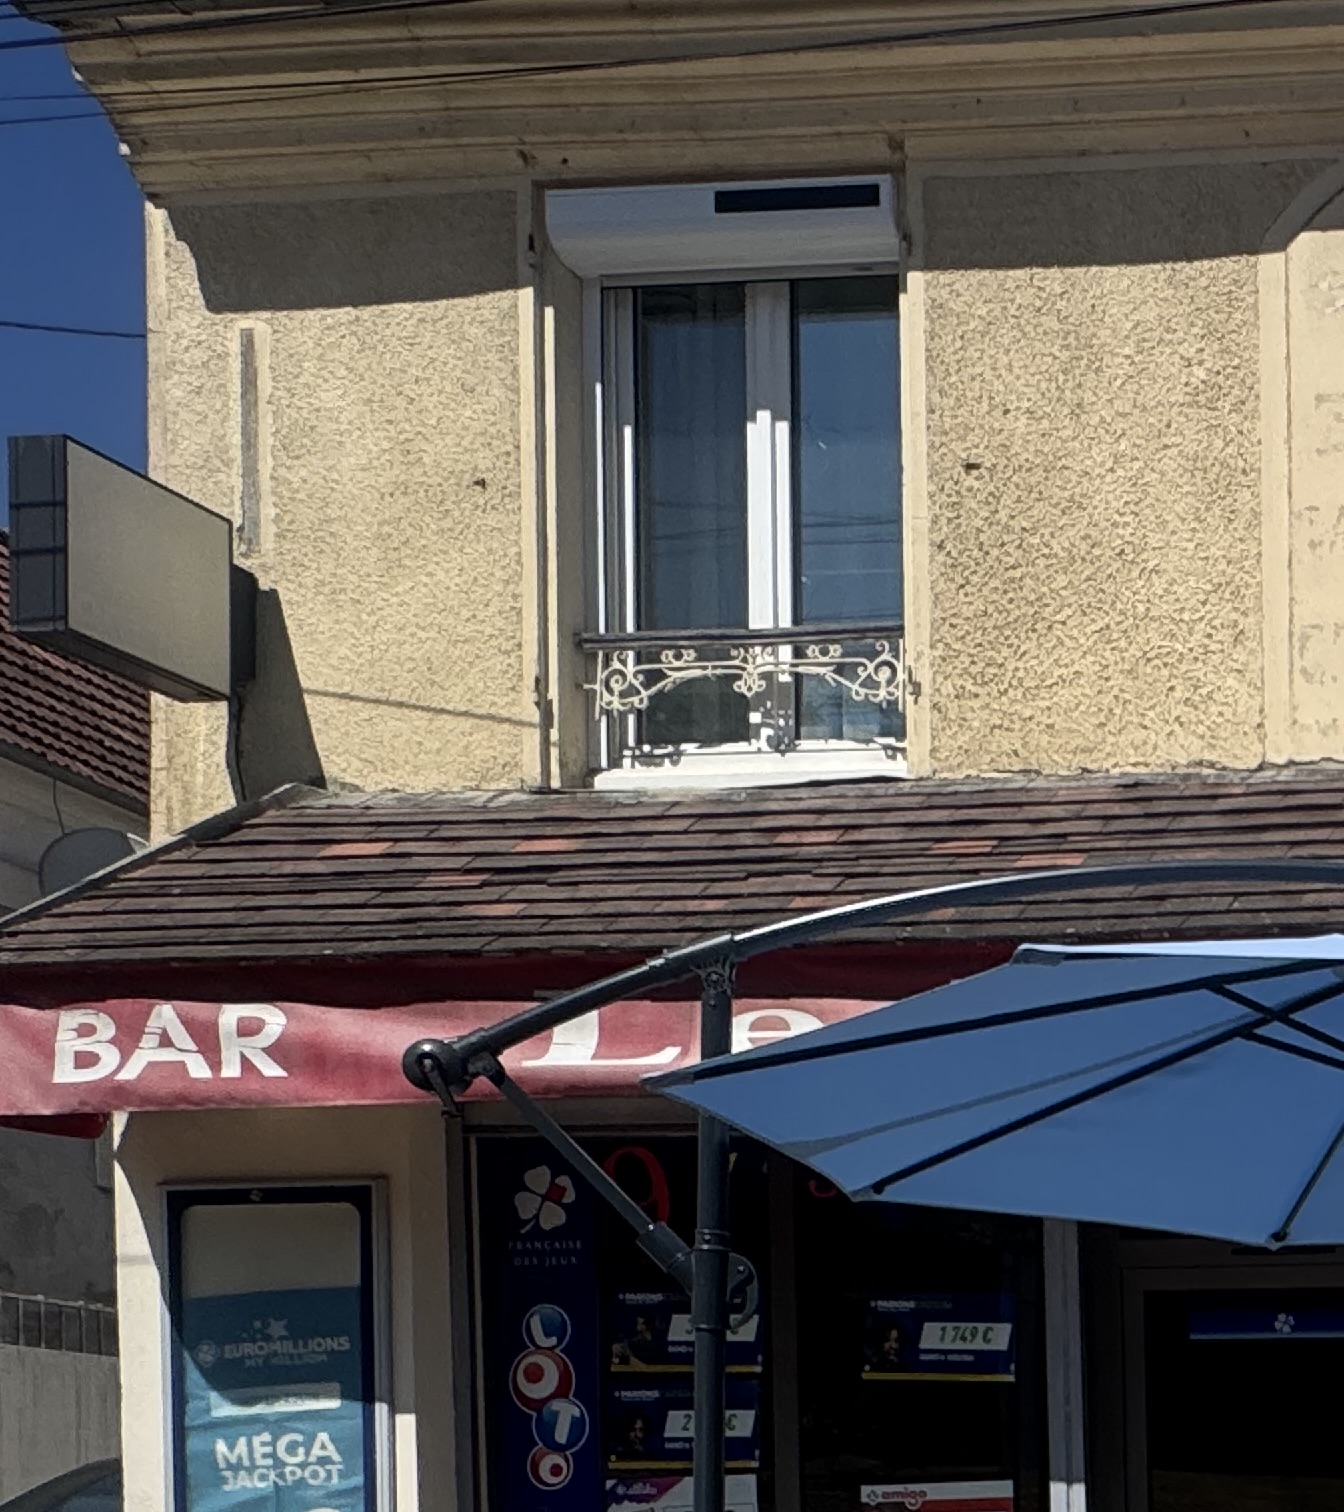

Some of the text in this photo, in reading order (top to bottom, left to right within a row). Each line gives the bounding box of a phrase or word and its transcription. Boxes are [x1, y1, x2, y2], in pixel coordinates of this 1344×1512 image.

[52, 1003, 290, 1085] BAR
[507, 1239, 583, 1253] FRANÇAISE
[543, 1256, 579, 1268] JEUX
[223, 1336, 351, 1361] EUROMILLIONS
[219, 1463, 344, 1491] JACKPOT
[881, 1486, 928, 1507] amigo
